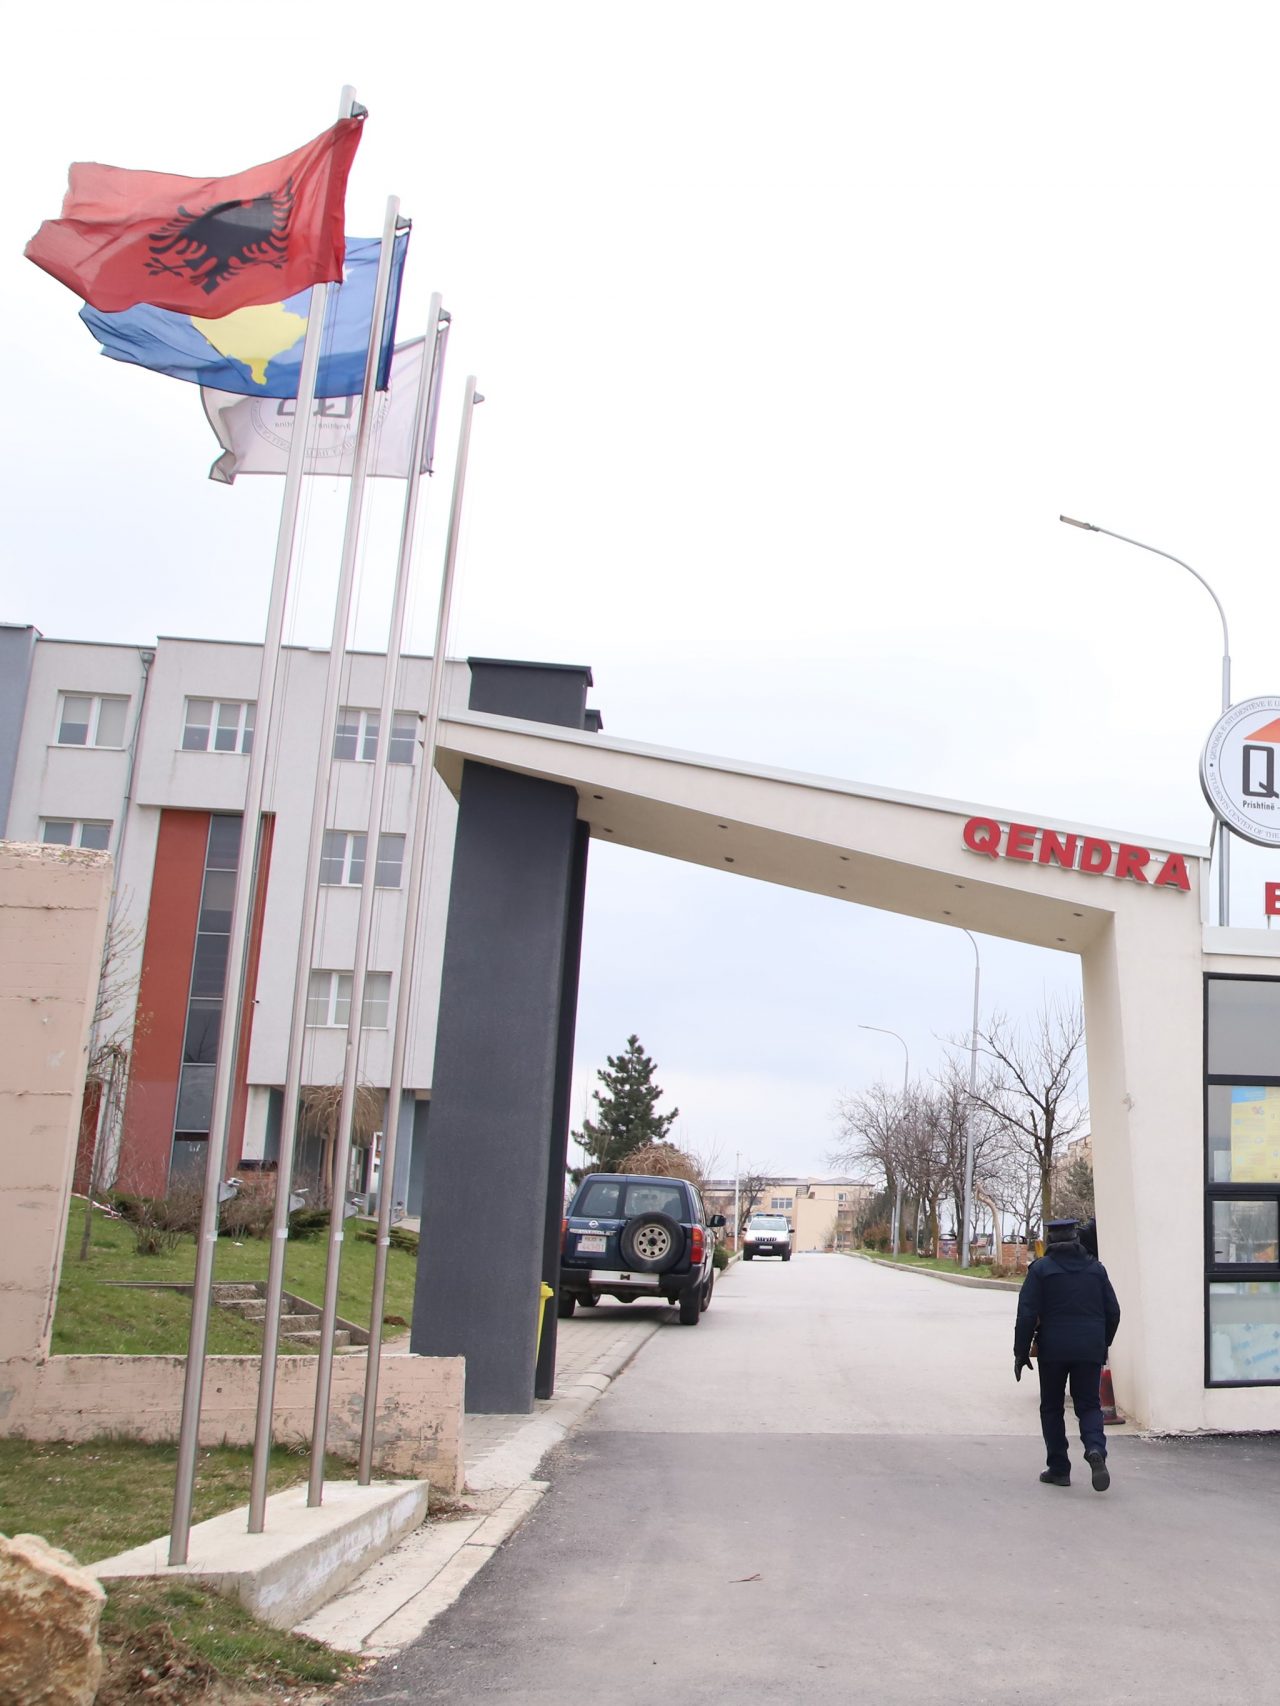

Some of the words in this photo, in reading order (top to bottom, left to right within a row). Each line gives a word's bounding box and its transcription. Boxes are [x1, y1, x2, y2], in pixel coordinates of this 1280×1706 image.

[1242, 800, 1275, 811] Prishtinë
[1228, 808, 1254, 832] CENTER
[1253, 826, 1264, 836] OF
[1265, 830, 1280, 839] THE
[963, 815, 1192, 892] QENDRA
